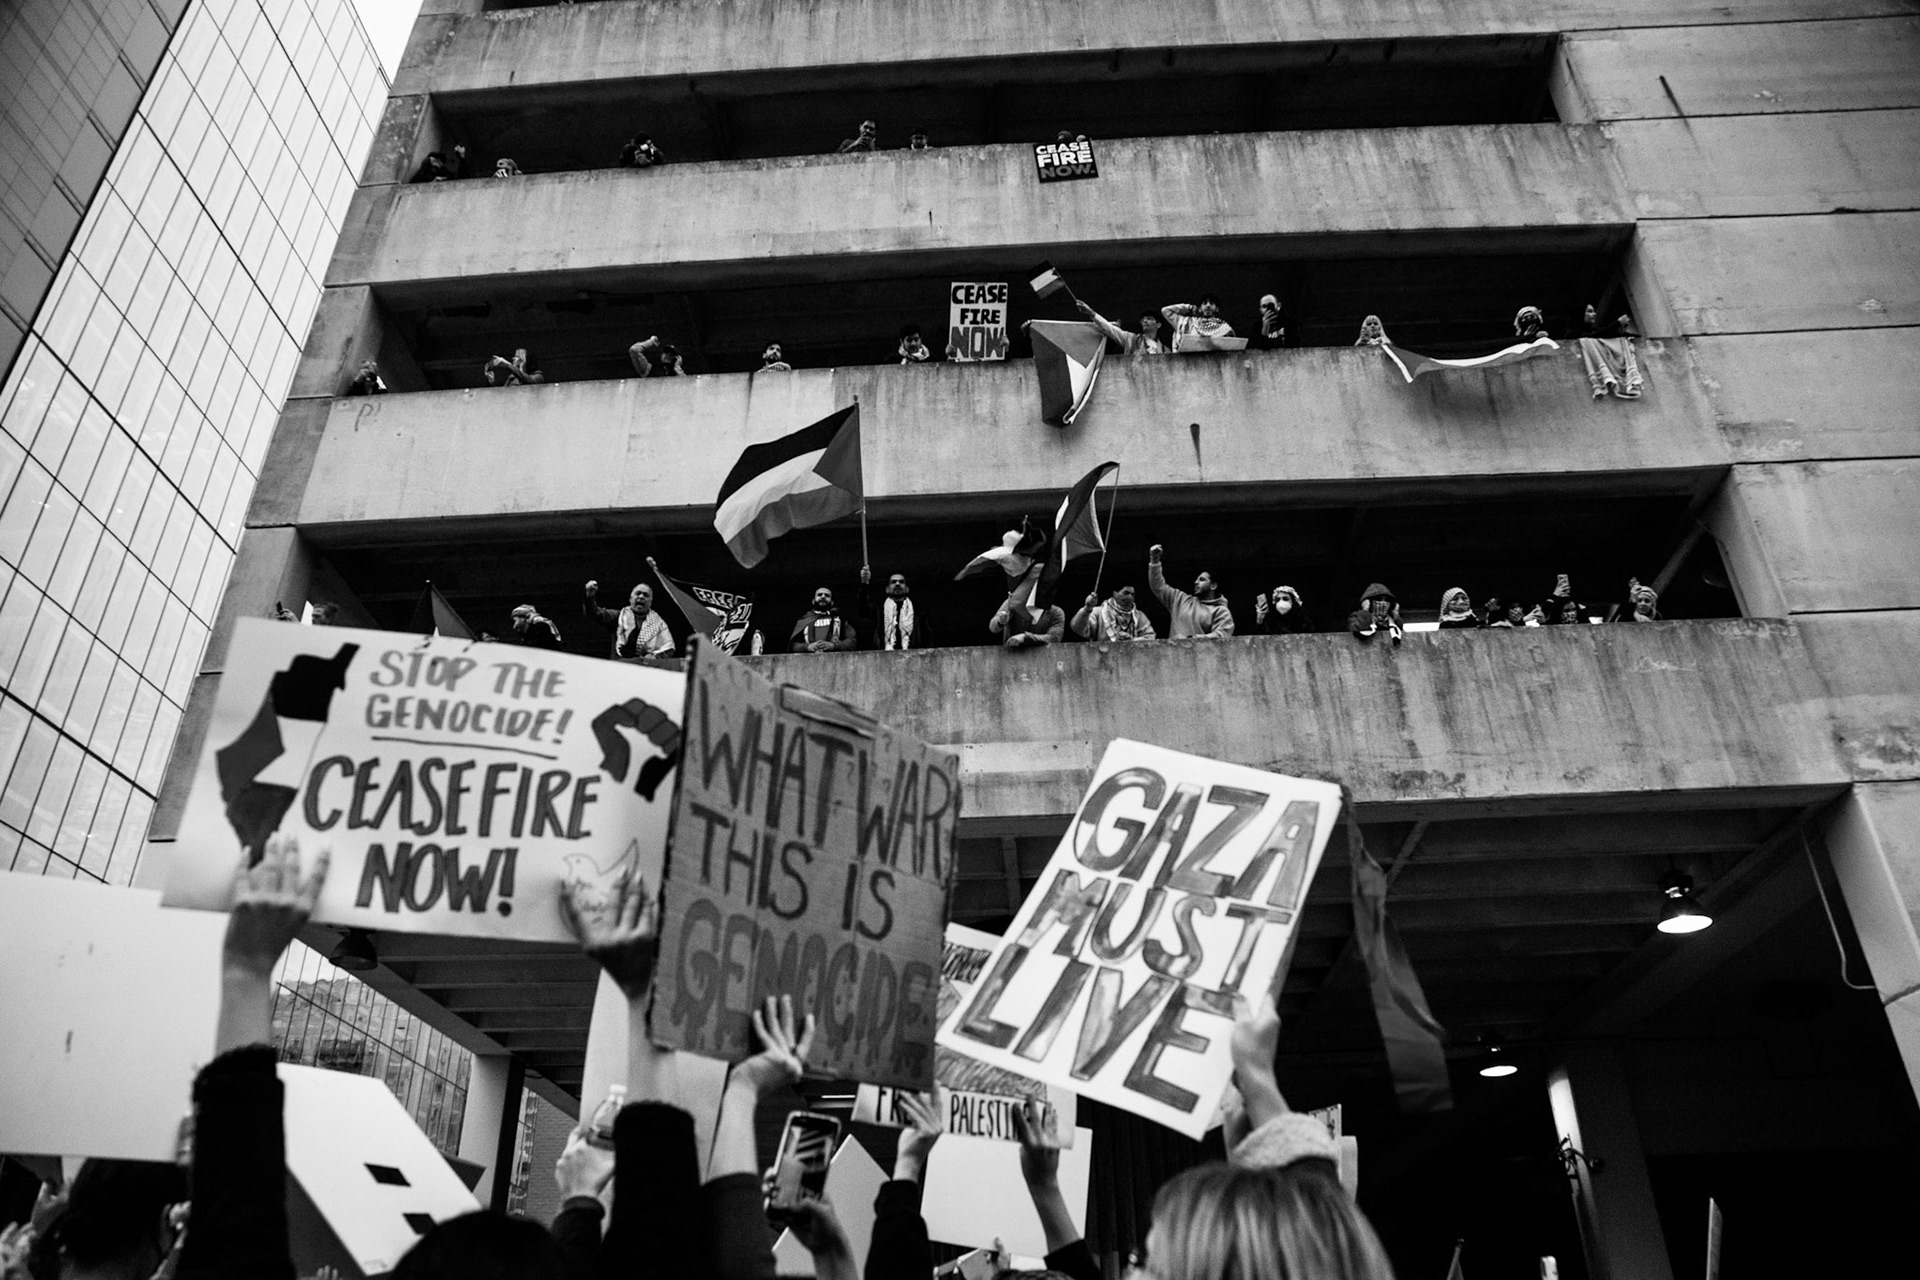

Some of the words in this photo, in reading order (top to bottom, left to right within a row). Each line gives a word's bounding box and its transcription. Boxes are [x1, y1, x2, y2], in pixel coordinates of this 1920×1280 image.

[1036, 141, 1091, 154] CEASE
[1037, 150, 1093, 168] FIRE
[952, 284, 1007, 304] CEASE
[960, 308, 1001, 325] FIRE
[949, 326, 1004, 358] NOW
[369, 650, 477, 692] STOP
[491, 662, 566, 699] THE
[365, 693, 573, 745] GENOCIDE!
[700, 677, 854, 849] WHAT
[857, 750, 951, 880] WAR
[1073, 767, 1320, 910] GAZA
[355, 842, 518, 917] NOW!
[690, 801, 814, 921] THIS
[841, 863, 896, 941] IS
[1017, 868, 1292, 993] MUST
[953, 942, 1244, 1114] LIVE
